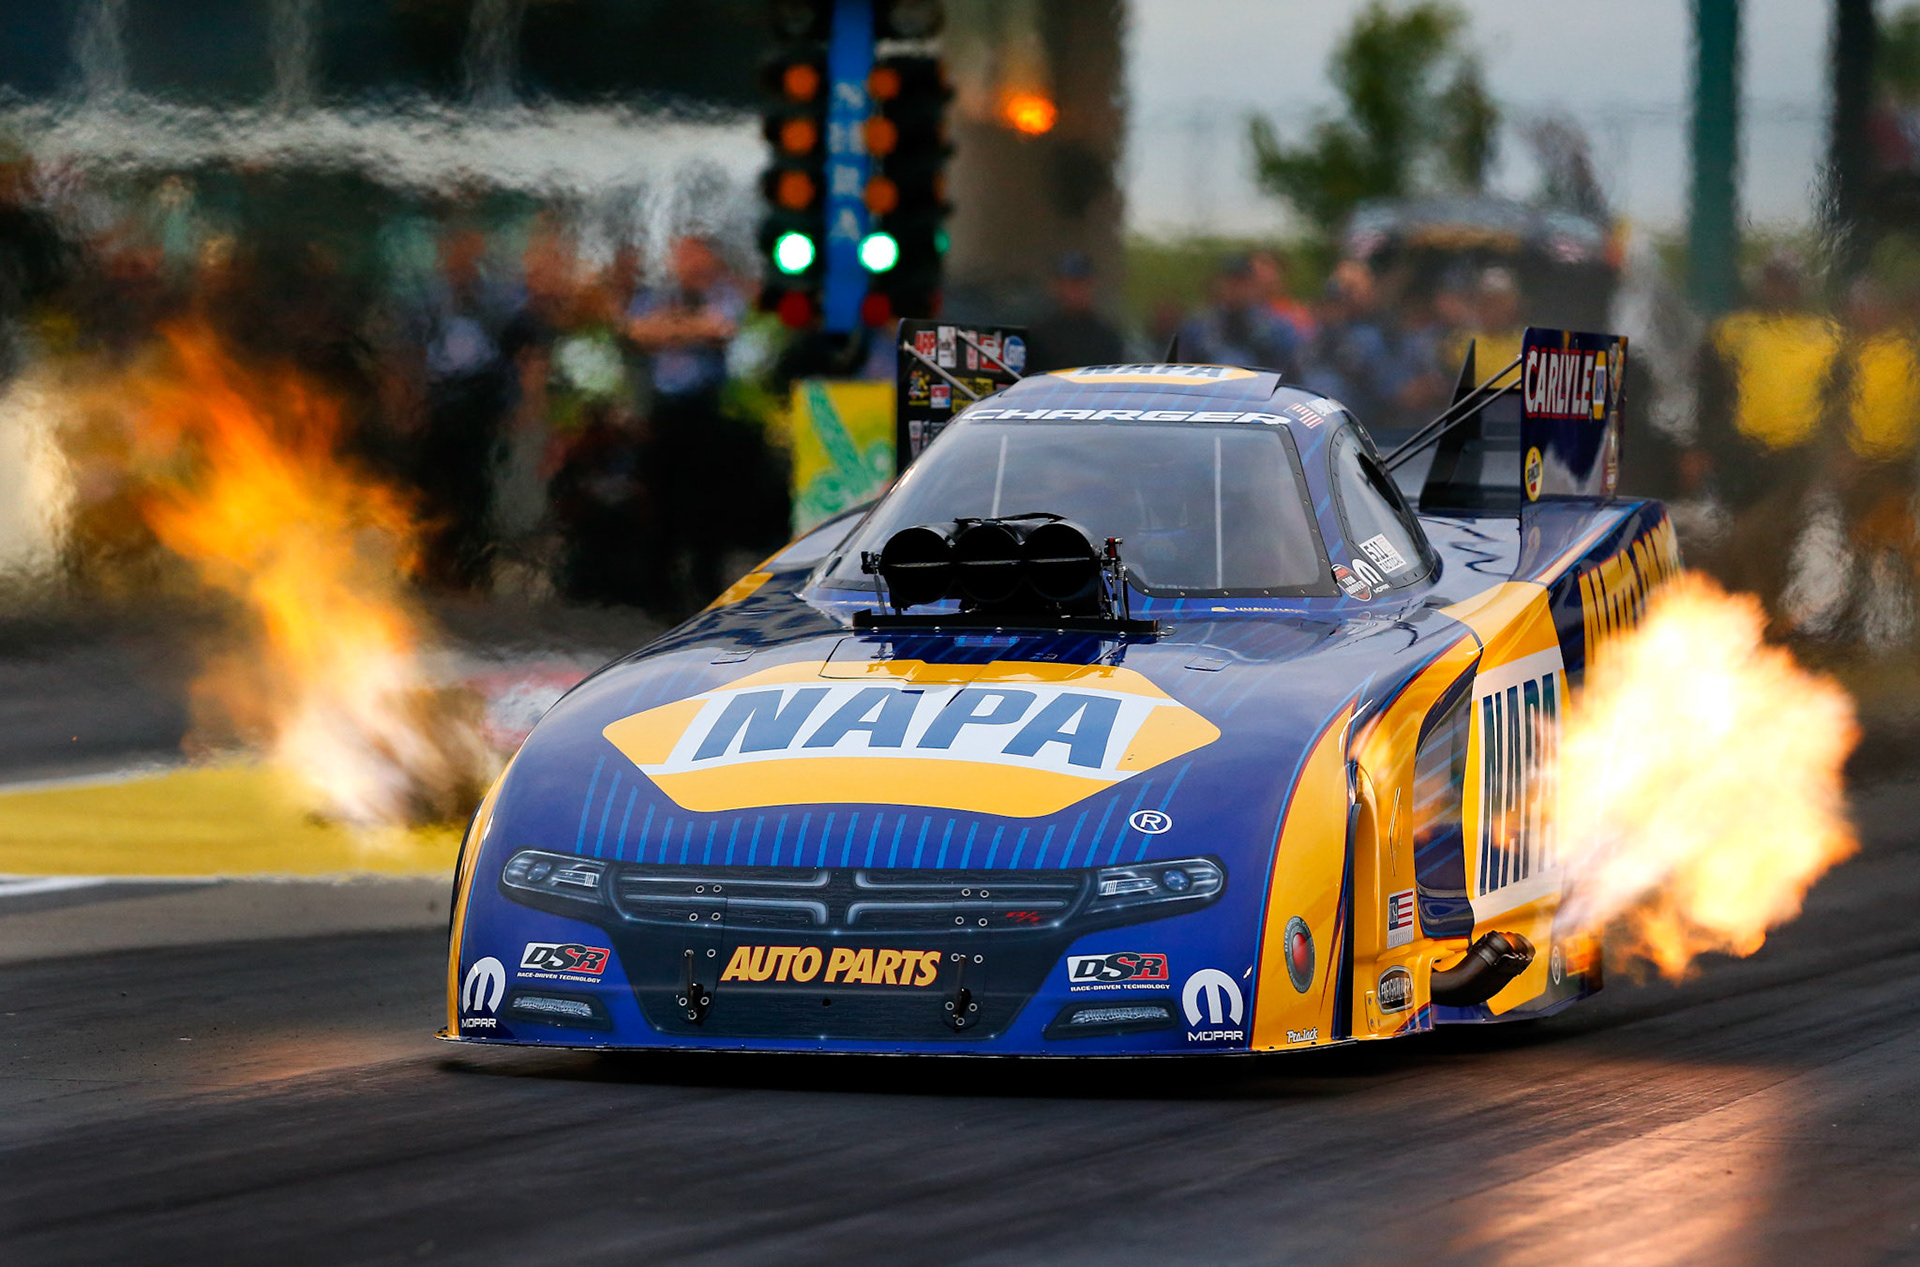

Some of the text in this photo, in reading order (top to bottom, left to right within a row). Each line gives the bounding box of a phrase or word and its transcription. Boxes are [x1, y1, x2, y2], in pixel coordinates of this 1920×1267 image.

[1079, 363, 1225, 378] NAPA
[1524, 346, 1595, 419] CARLYLE
[962, 409, 1291, 425] CHARGER
[691, 685, 1122, 769] NAPA
[1479, 672, 1558, 897] NAPA
[524, 944, 606, 971] DSR
[720, 946, 942, 987] AUTO PARTS
[1073, 952, 1164, 982] DSR
[516, 972, 601, 984] RACE-DRIVEN TECHNOLOGY
[1070, 983, 1121, 992] RACE-DRIVEN
[461, 1017, 497, 1029] MOPAR
[1187, 1030, 1244, 1042] MOPAR
